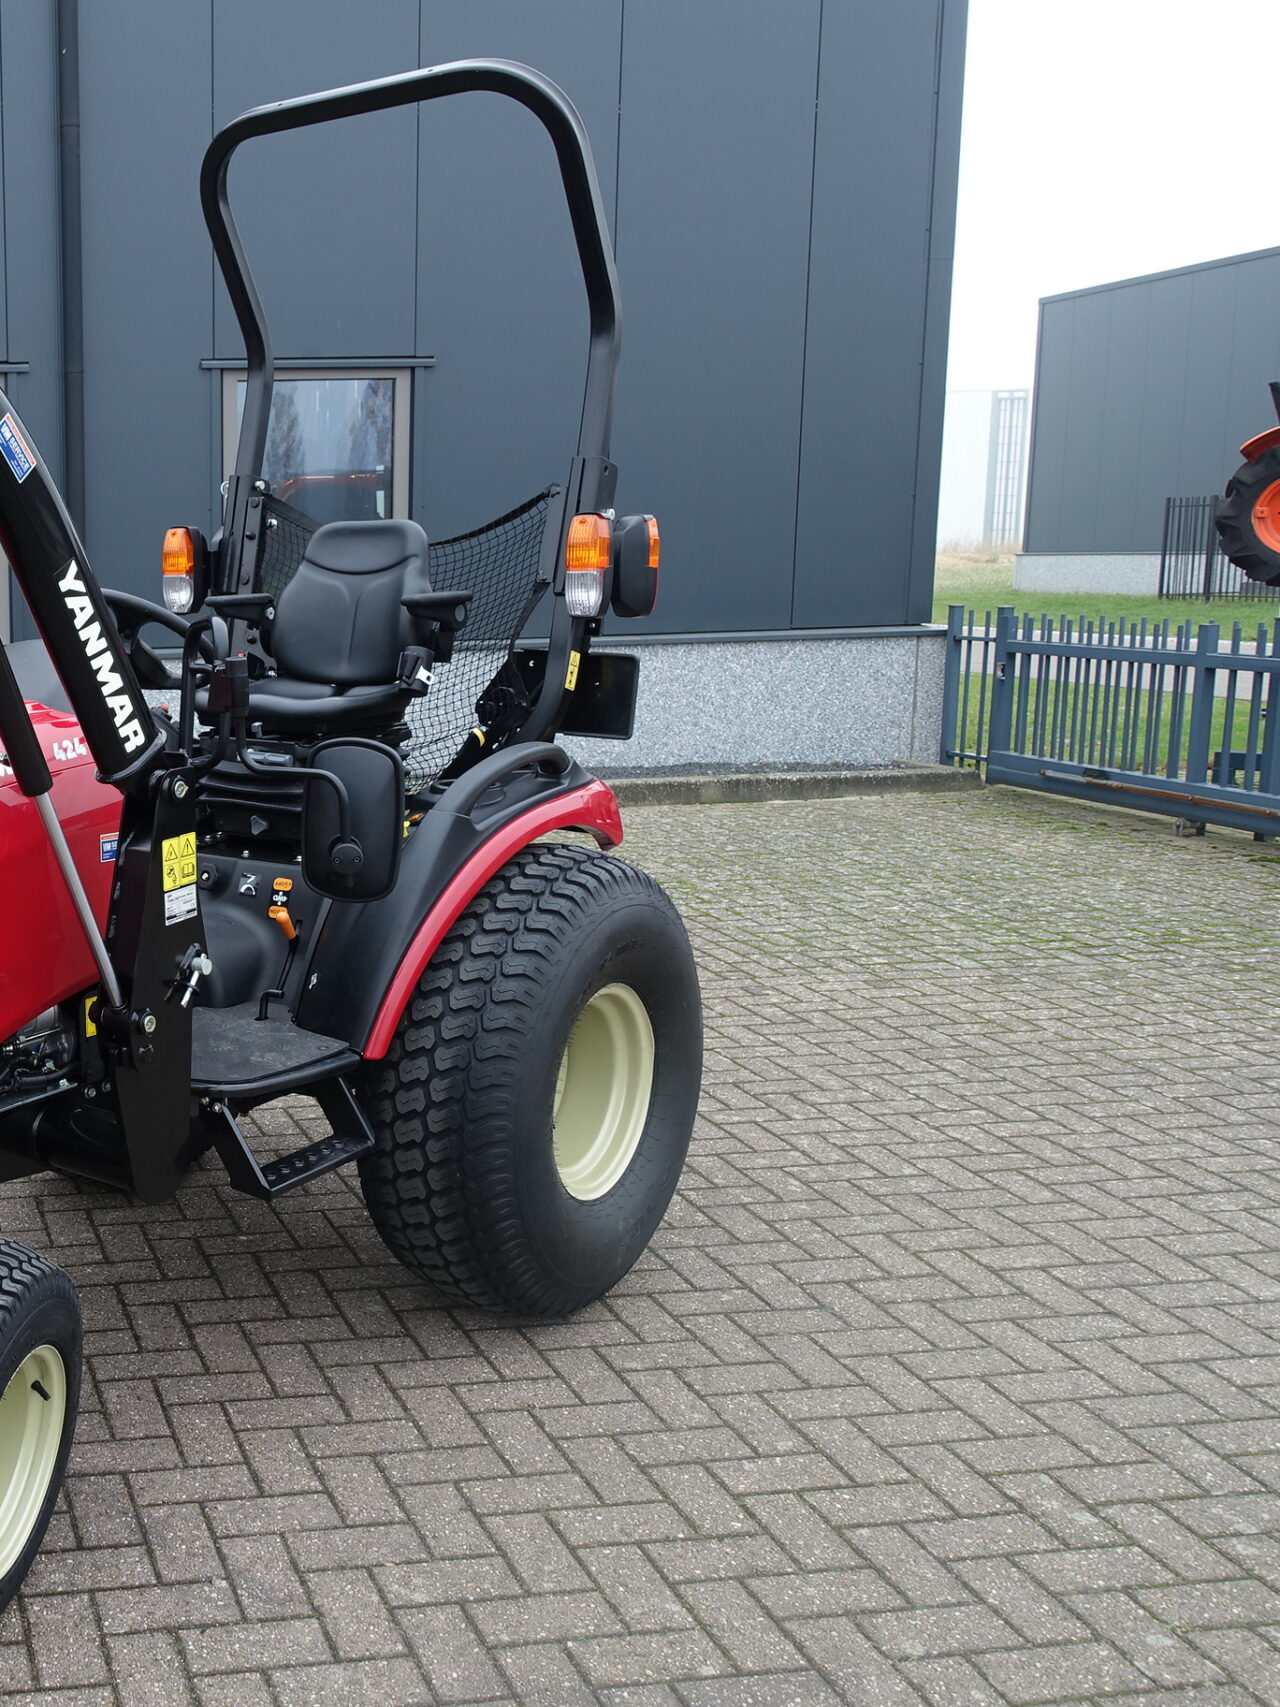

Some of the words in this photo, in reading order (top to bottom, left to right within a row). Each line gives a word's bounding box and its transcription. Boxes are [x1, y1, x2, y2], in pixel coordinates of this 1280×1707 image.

[9, 436, 31, 471] SERVICE
[58, 559, 146, 754] YANMAR
[52, 737, 88, 761] 424
